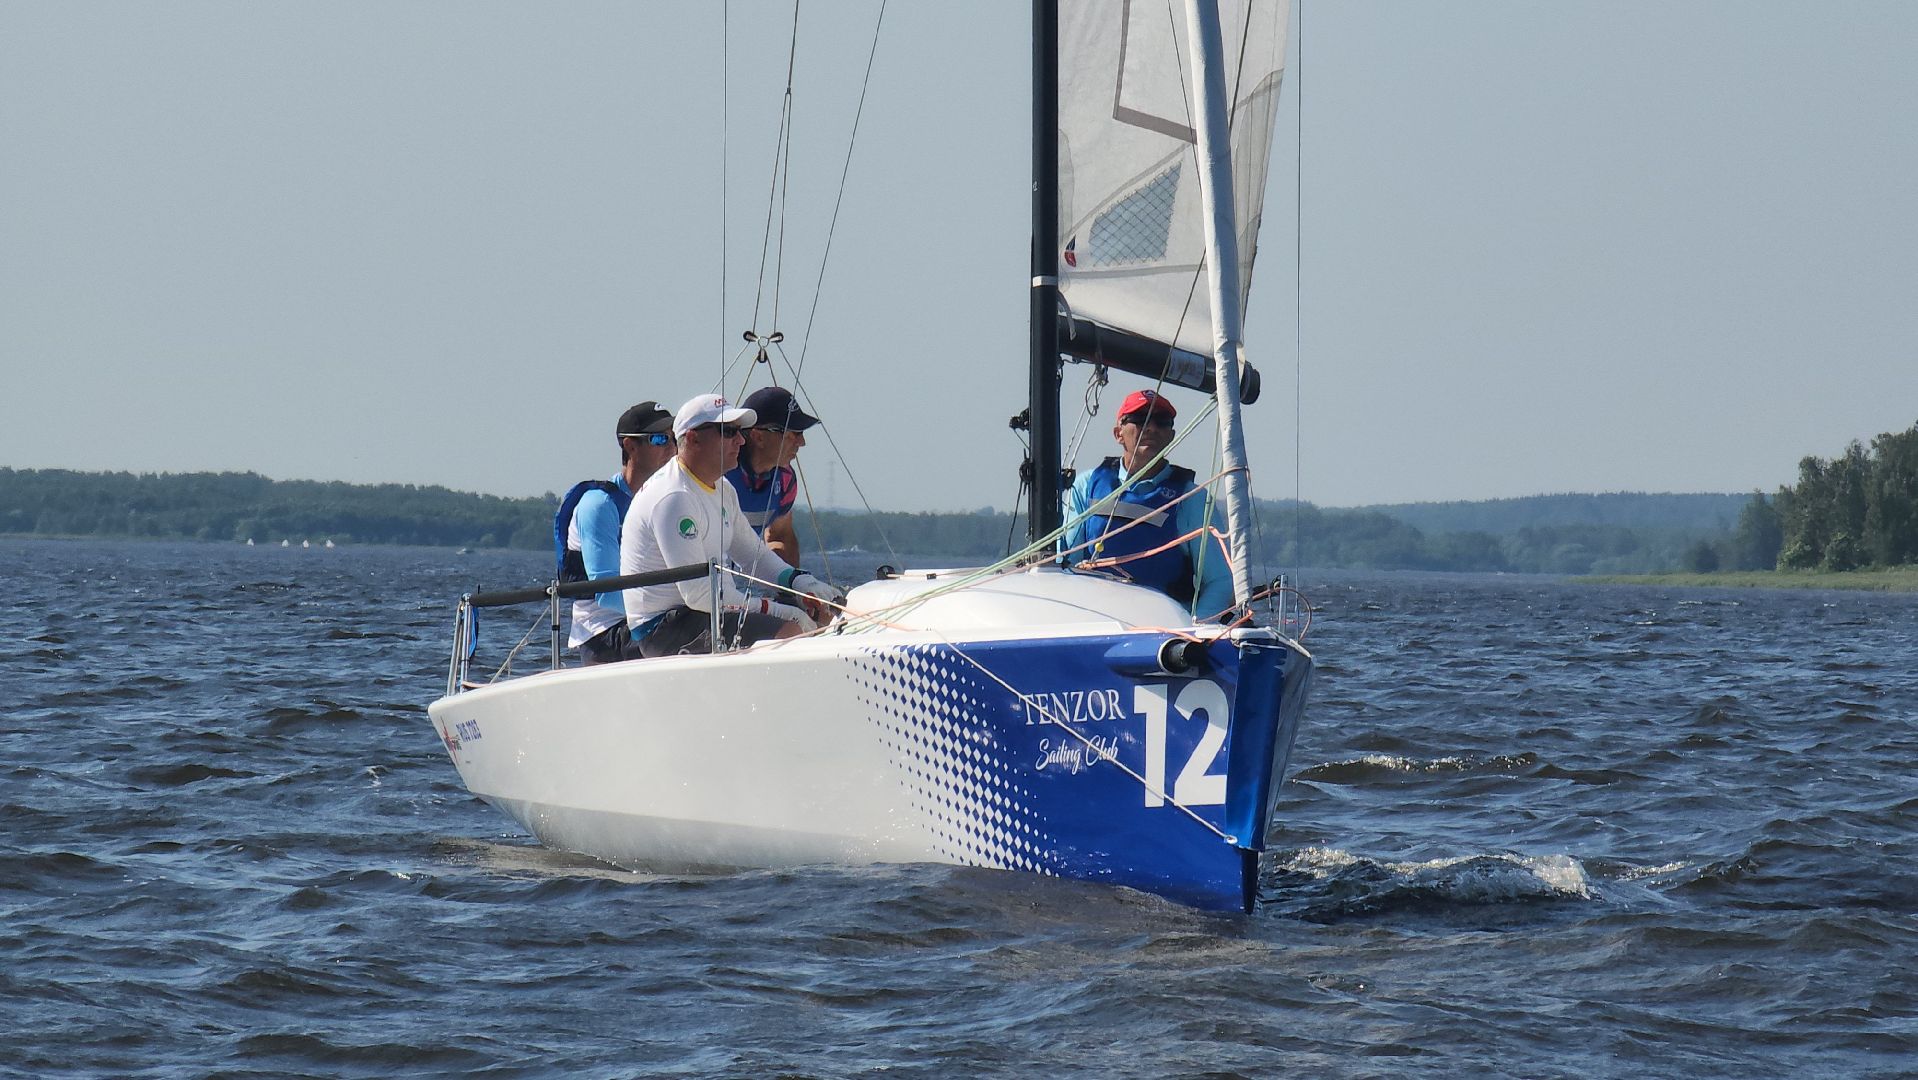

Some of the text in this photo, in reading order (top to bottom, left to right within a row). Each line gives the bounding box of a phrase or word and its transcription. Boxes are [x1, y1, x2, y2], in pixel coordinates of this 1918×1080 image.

[1018, 689, 1126, 726] TENZOR
[1035, 735, 1119, 775] Sailing Club
[1134, 680, 1229, 807] 12
